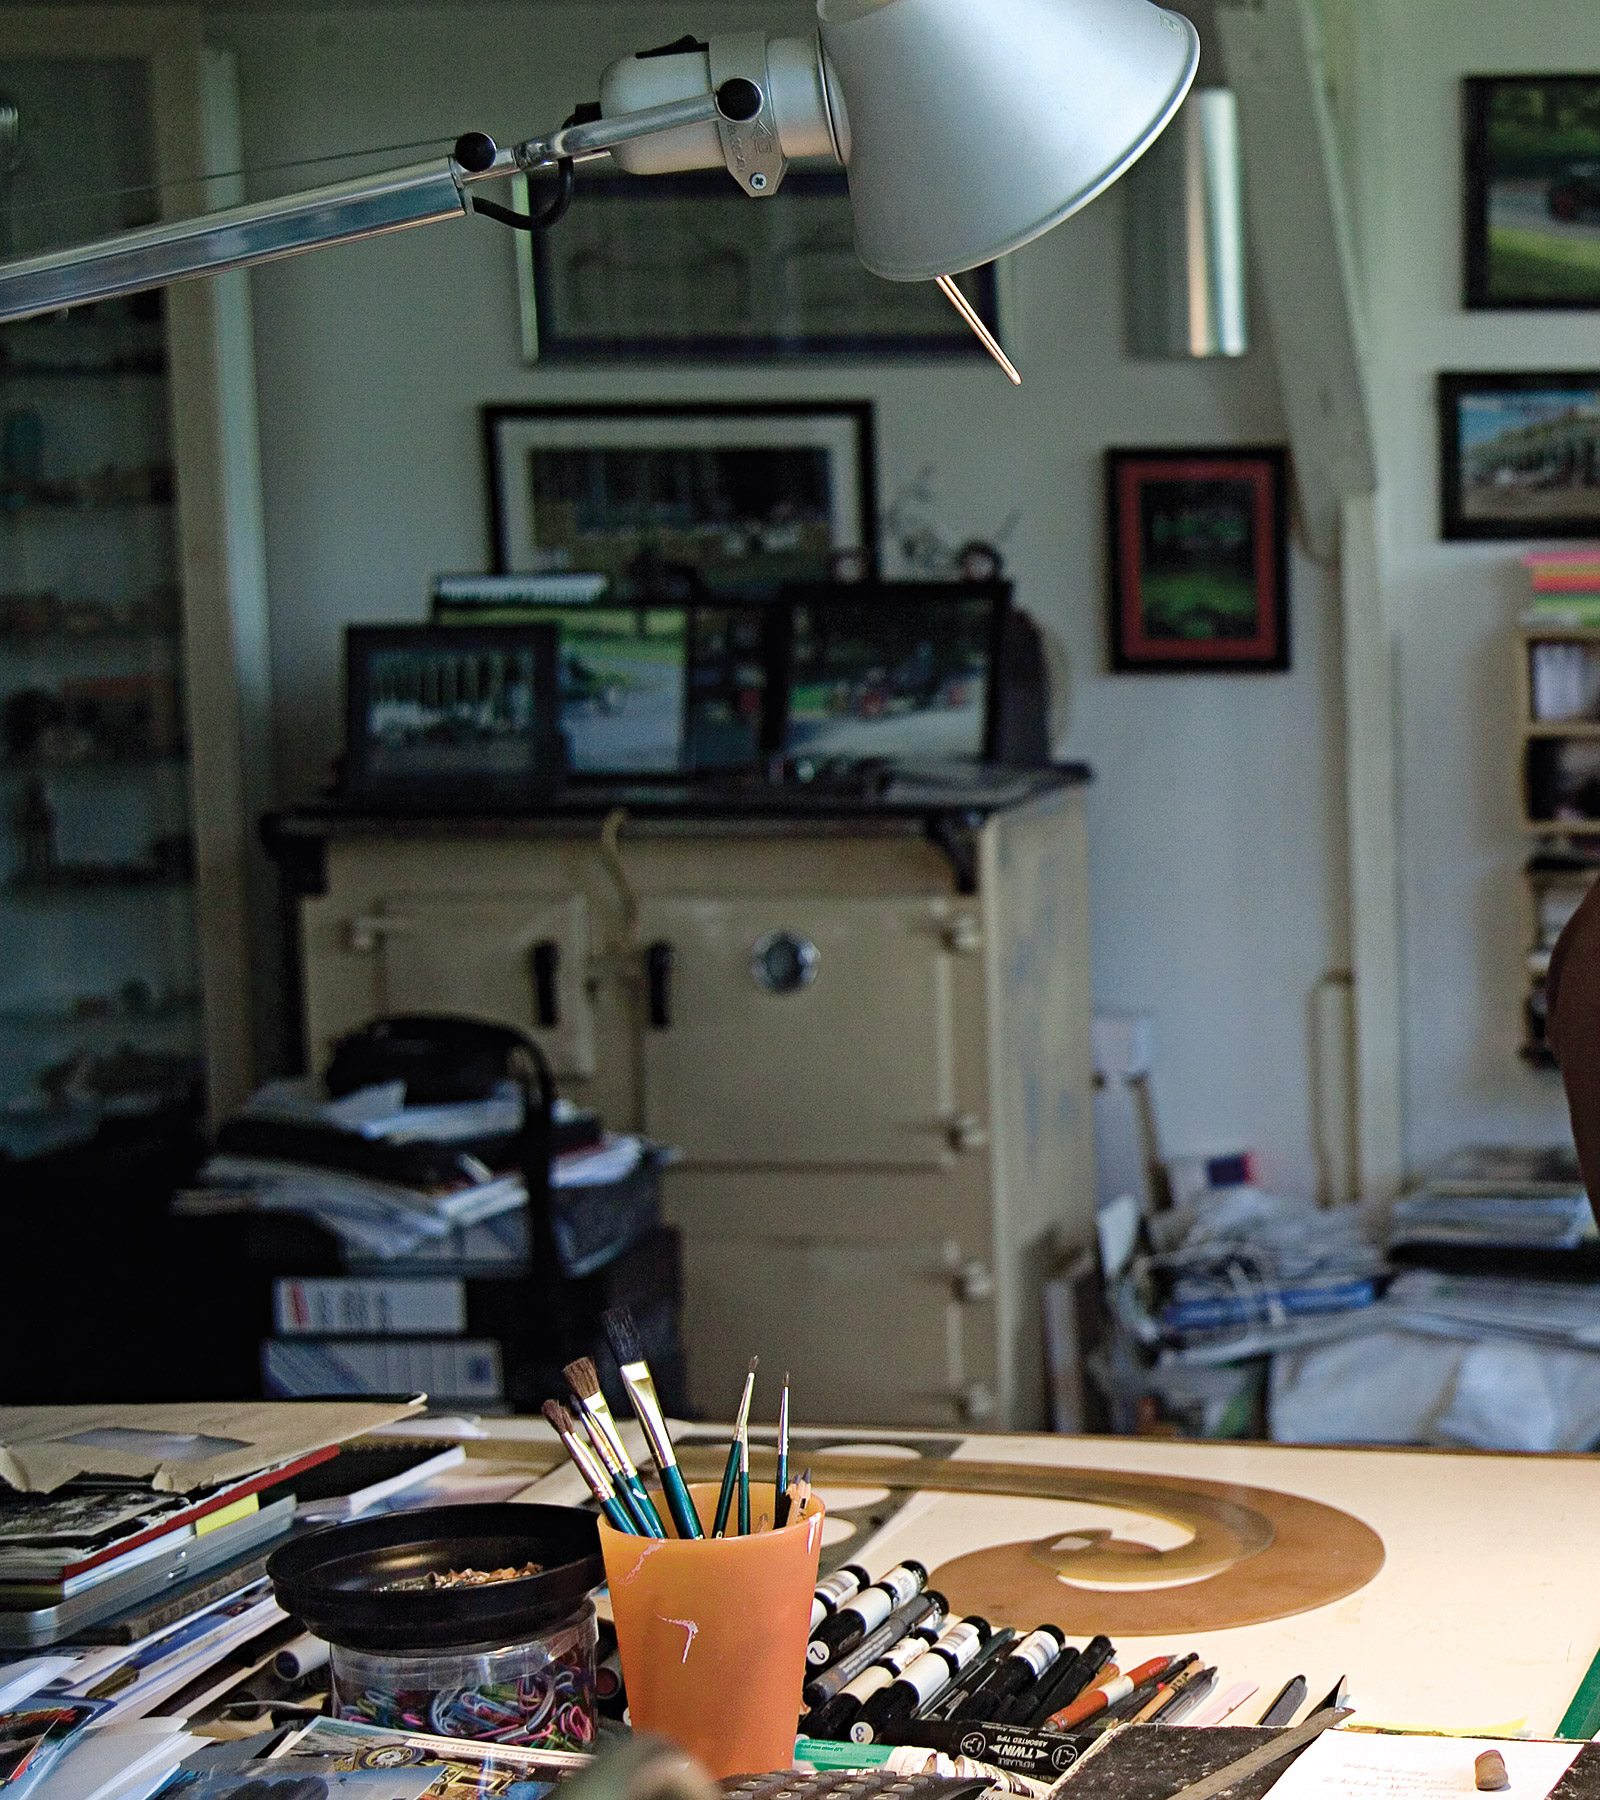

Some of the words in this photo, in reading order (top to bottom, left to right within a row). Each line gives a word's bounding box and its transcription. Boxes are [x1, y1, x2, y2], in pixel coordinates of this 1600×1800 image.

[855, 1727, 865, 1742] 3
[996, 1734, 1012, 1743] TIPS
[1012, 1736, 1048, 1747] ASSORTED
[1002, 1744, 1034, 1758] TWIN
[997, 1758, 1035, 1769] REFILLABLE
